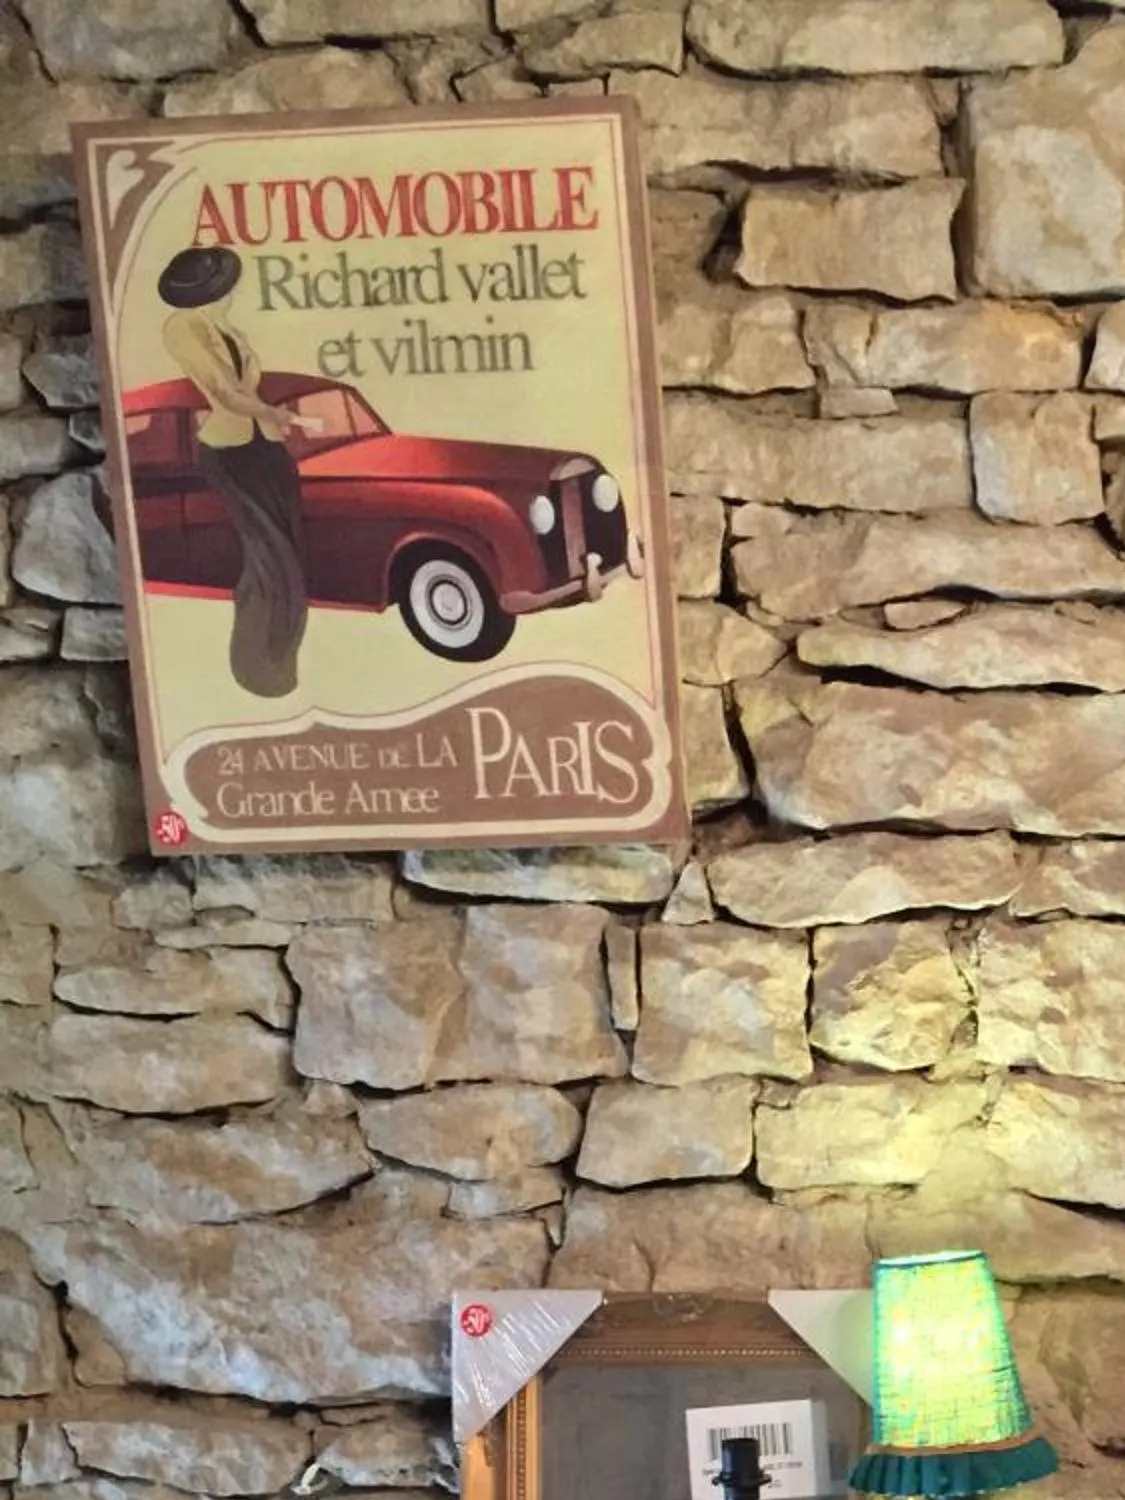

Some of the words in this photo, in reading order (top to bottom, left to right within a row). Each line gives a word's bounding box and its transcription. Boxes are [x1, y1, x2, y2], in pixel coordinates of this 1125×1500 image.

[192, 166, 600, 248] AUTOMOBILE
[254, 247, 448, 311] Richard
[456, 243, 588, 303] vallet
[317, 330, 361, 379] et
[372, 316, 535, 375] vilmin
[253, 742, 371, 772] AVENUE
[415, 732, 459, 769] LA
[465, 706, 641, 804] PARIS
[215, 779, 336, 818] Grande
